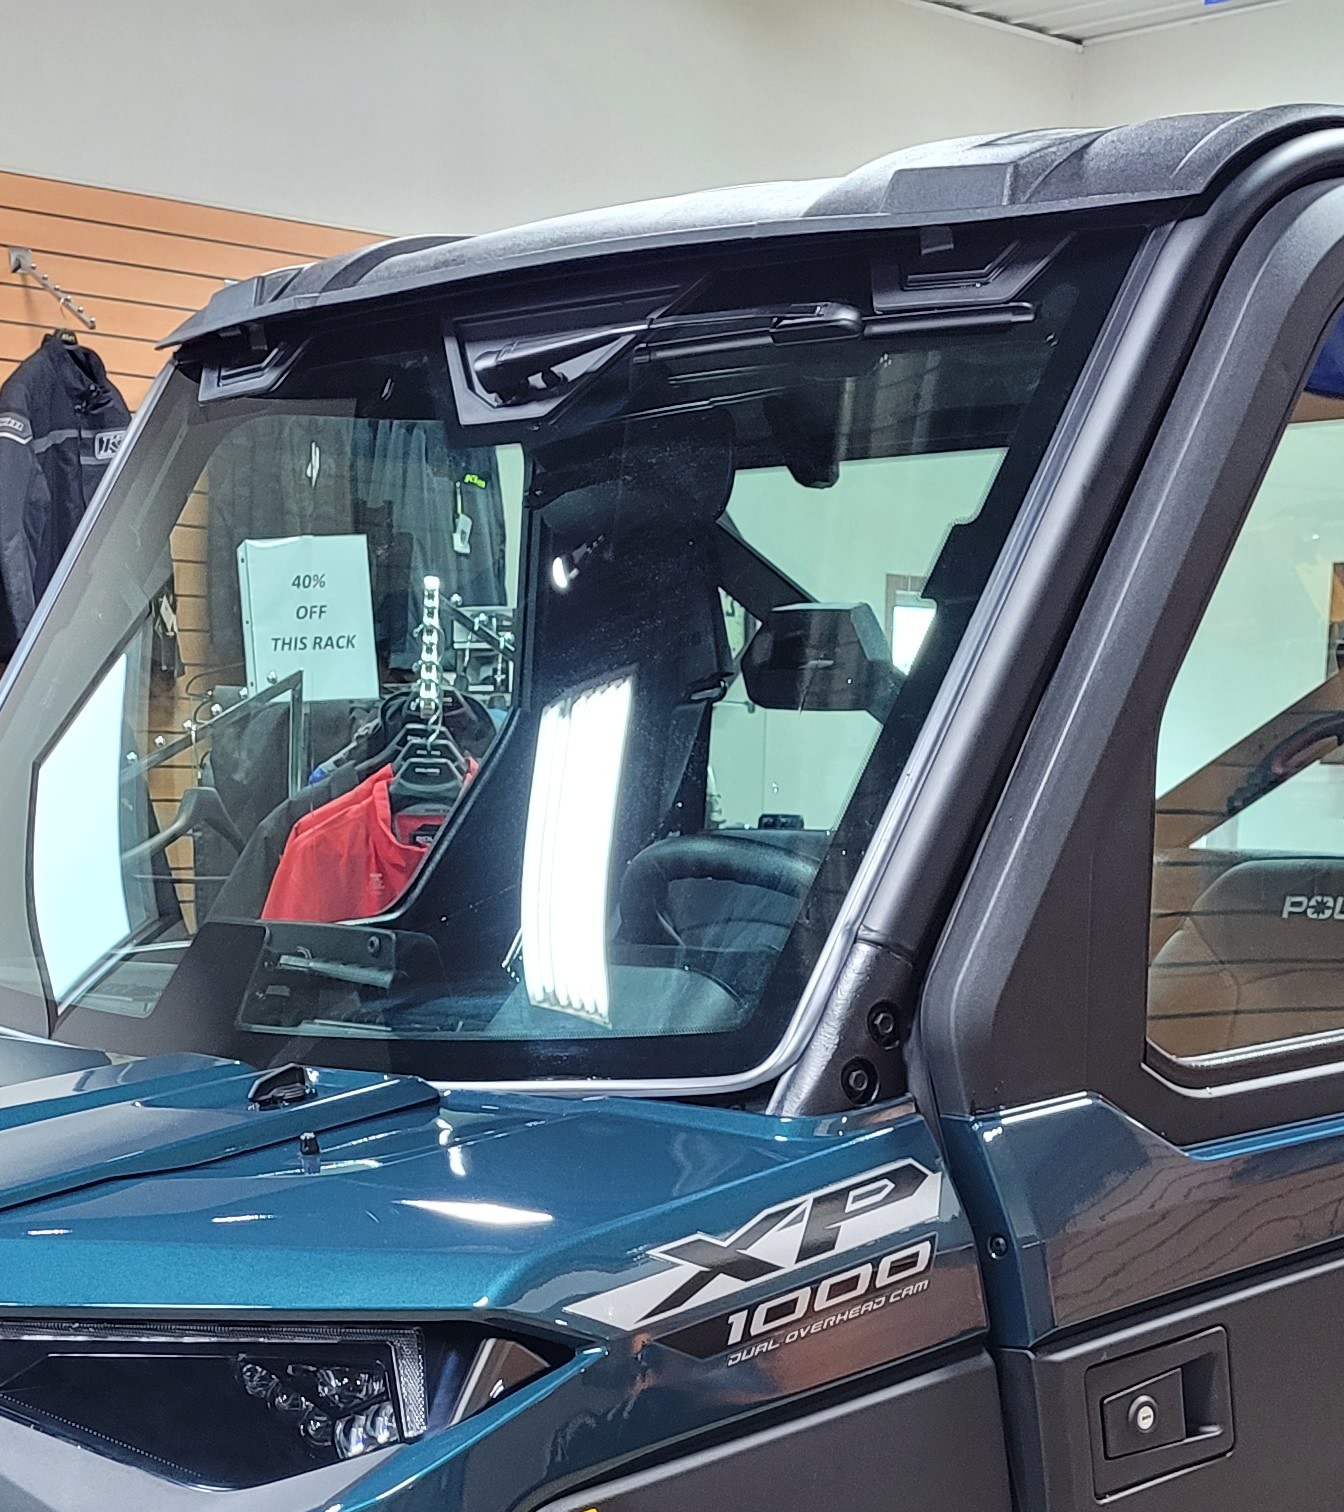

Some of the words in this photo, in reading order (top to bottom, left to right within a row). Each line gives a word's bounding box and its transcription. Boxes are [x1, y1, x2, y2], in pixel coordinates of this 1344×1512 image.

[291, 573, 326, 589] 40%
[295, 604, 328, 620] OFF
[271, 637, 309, 653] THIS
[312, 633, 357, 652] RACK
[634, 1160, 930, 1324] XP
[726, 1240, 932, 1346] 1000
[727, 1338, 780, 1367] DUAL
[784, 1296, 886, 1345] OVERHEAD
[889, 1279, 929, 1304] CAM
